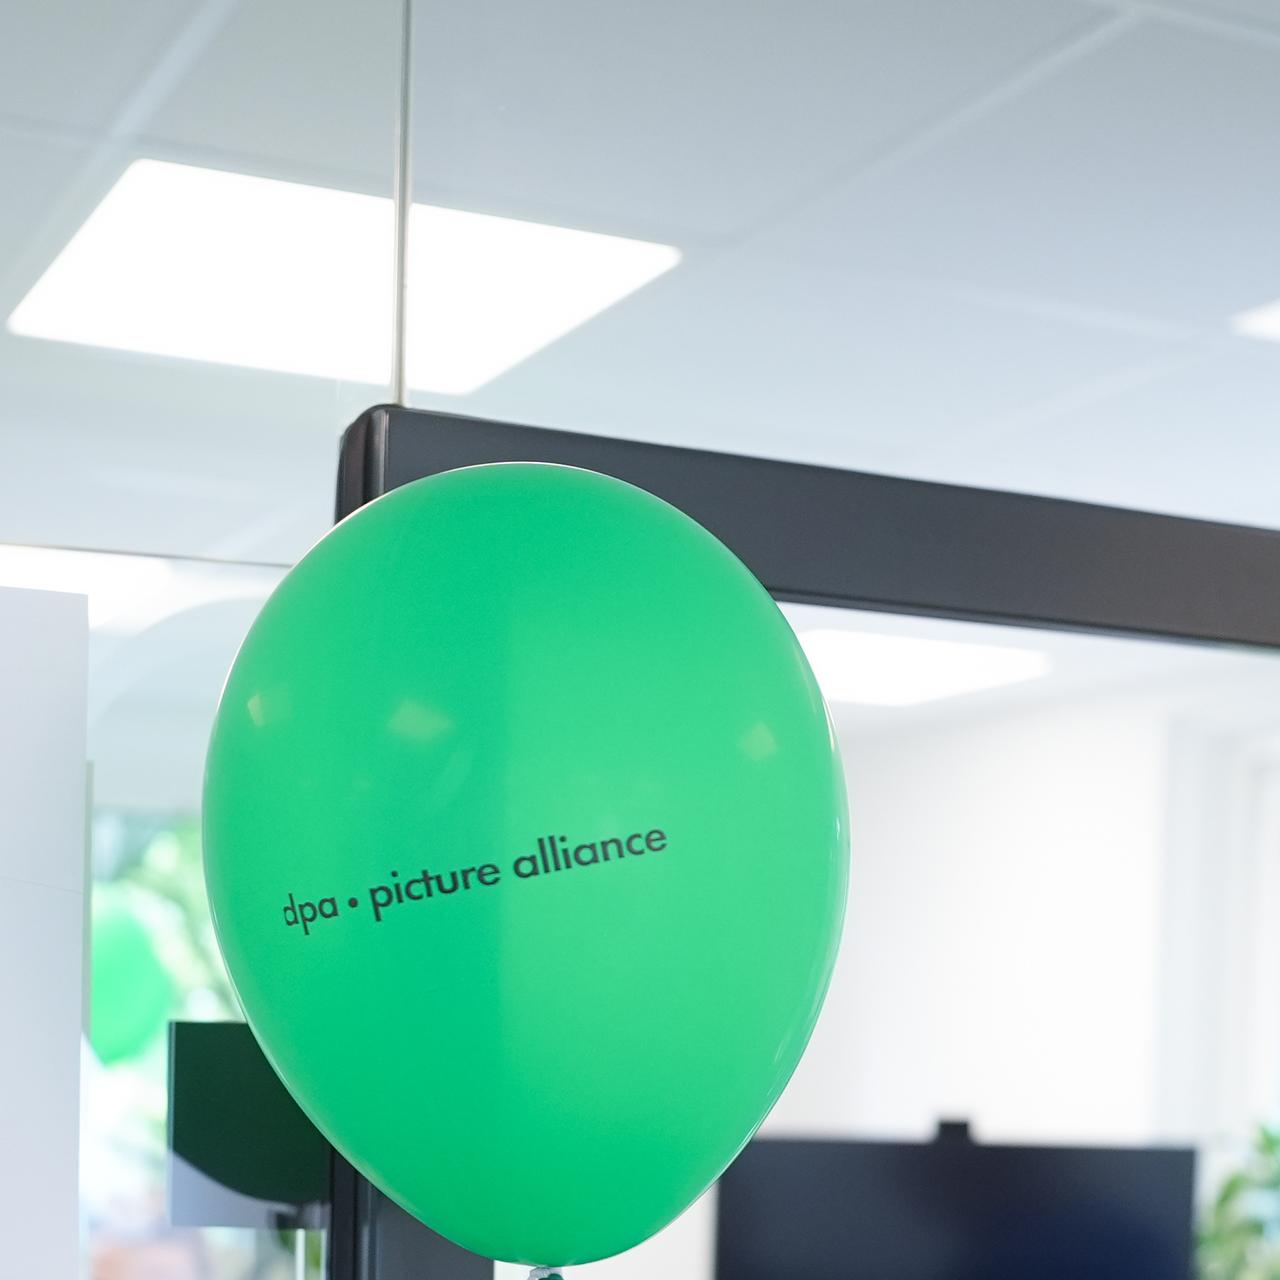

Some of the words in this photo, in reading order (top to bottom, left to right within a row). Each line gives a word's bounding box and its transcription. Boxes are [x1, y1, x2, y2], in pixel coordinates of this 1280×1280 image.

[282, 892, 340, 936] dpa
[368, 862, 501, 923] picture
[512, 828, 668, 880] alliance
